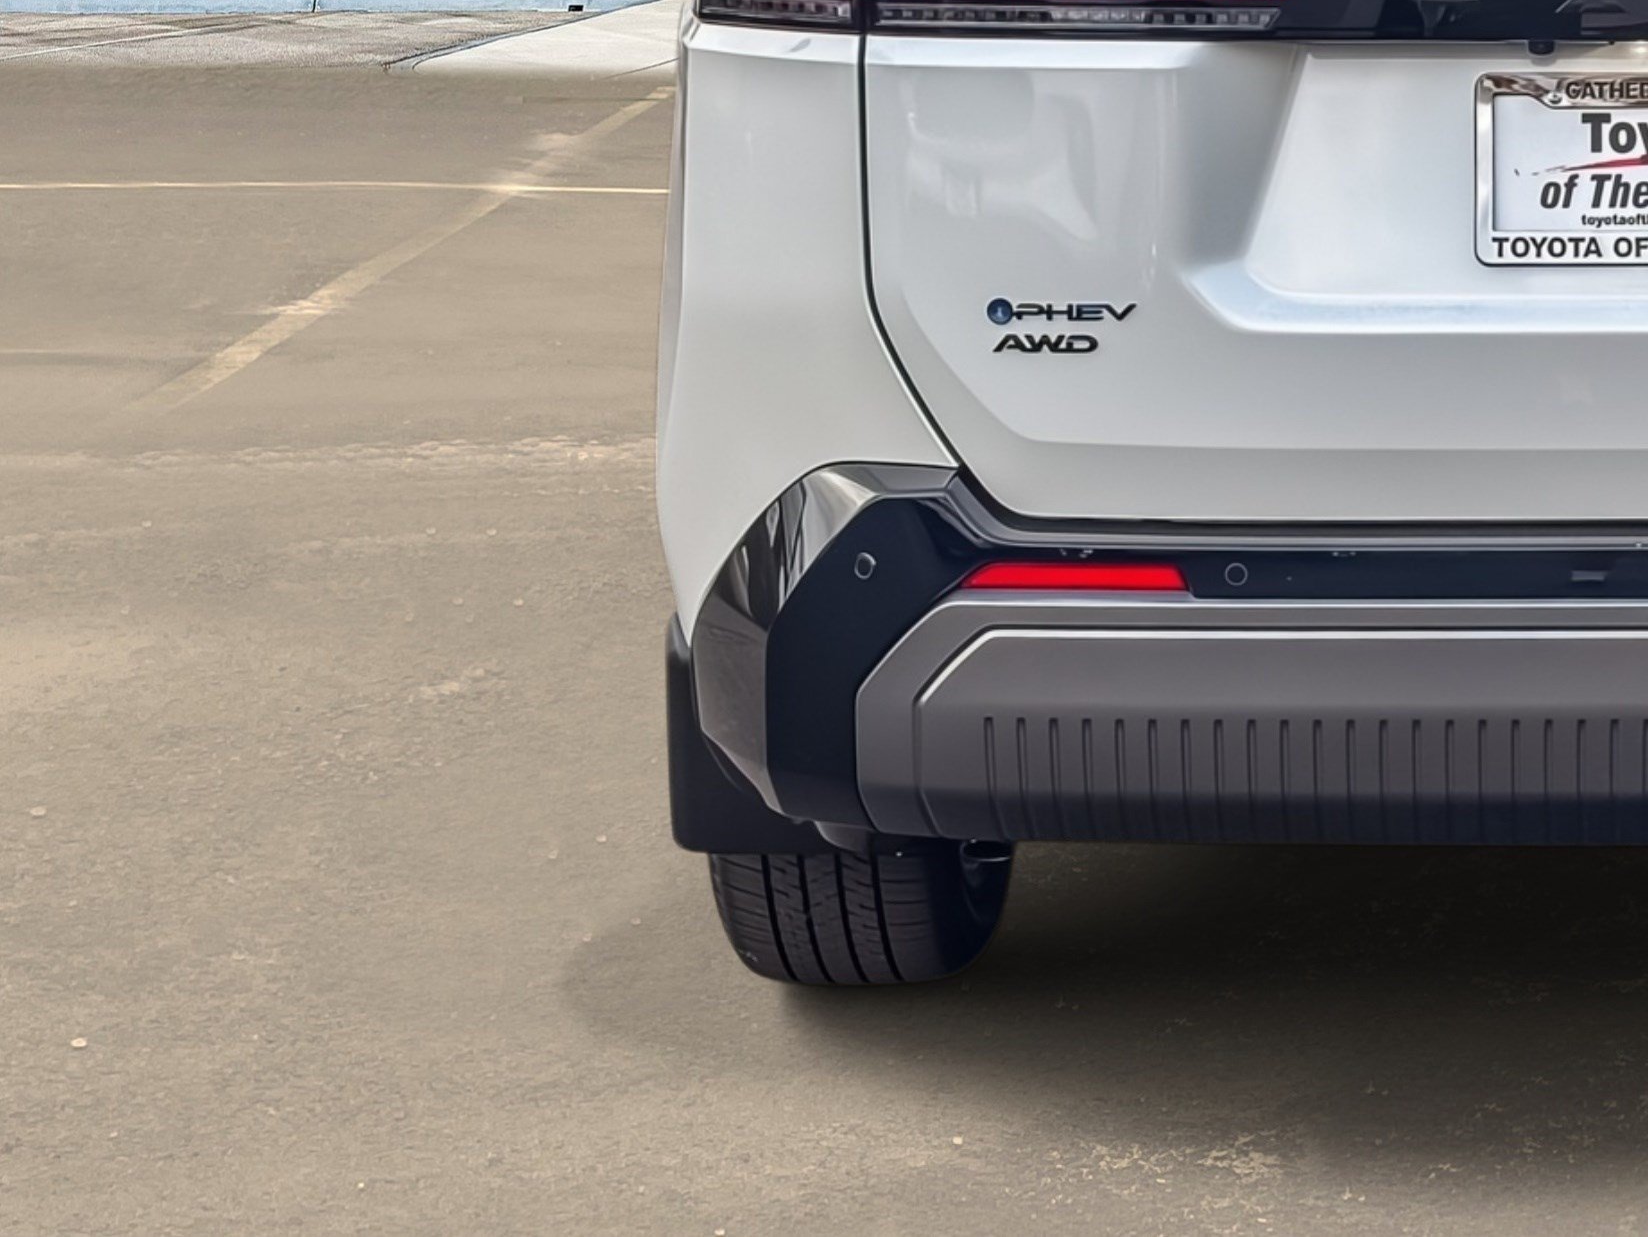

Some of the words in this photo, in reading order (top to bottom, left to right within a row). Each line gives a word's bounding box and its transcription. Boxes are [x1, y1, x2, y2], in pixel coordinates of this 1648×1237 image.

[1540, 173, 1577, 210] of
[1492, 236, 1603, 258] TOYOTA
[1013, 303, 1138, 322] PHEV
[993, 333, 1099, 354] AWD
